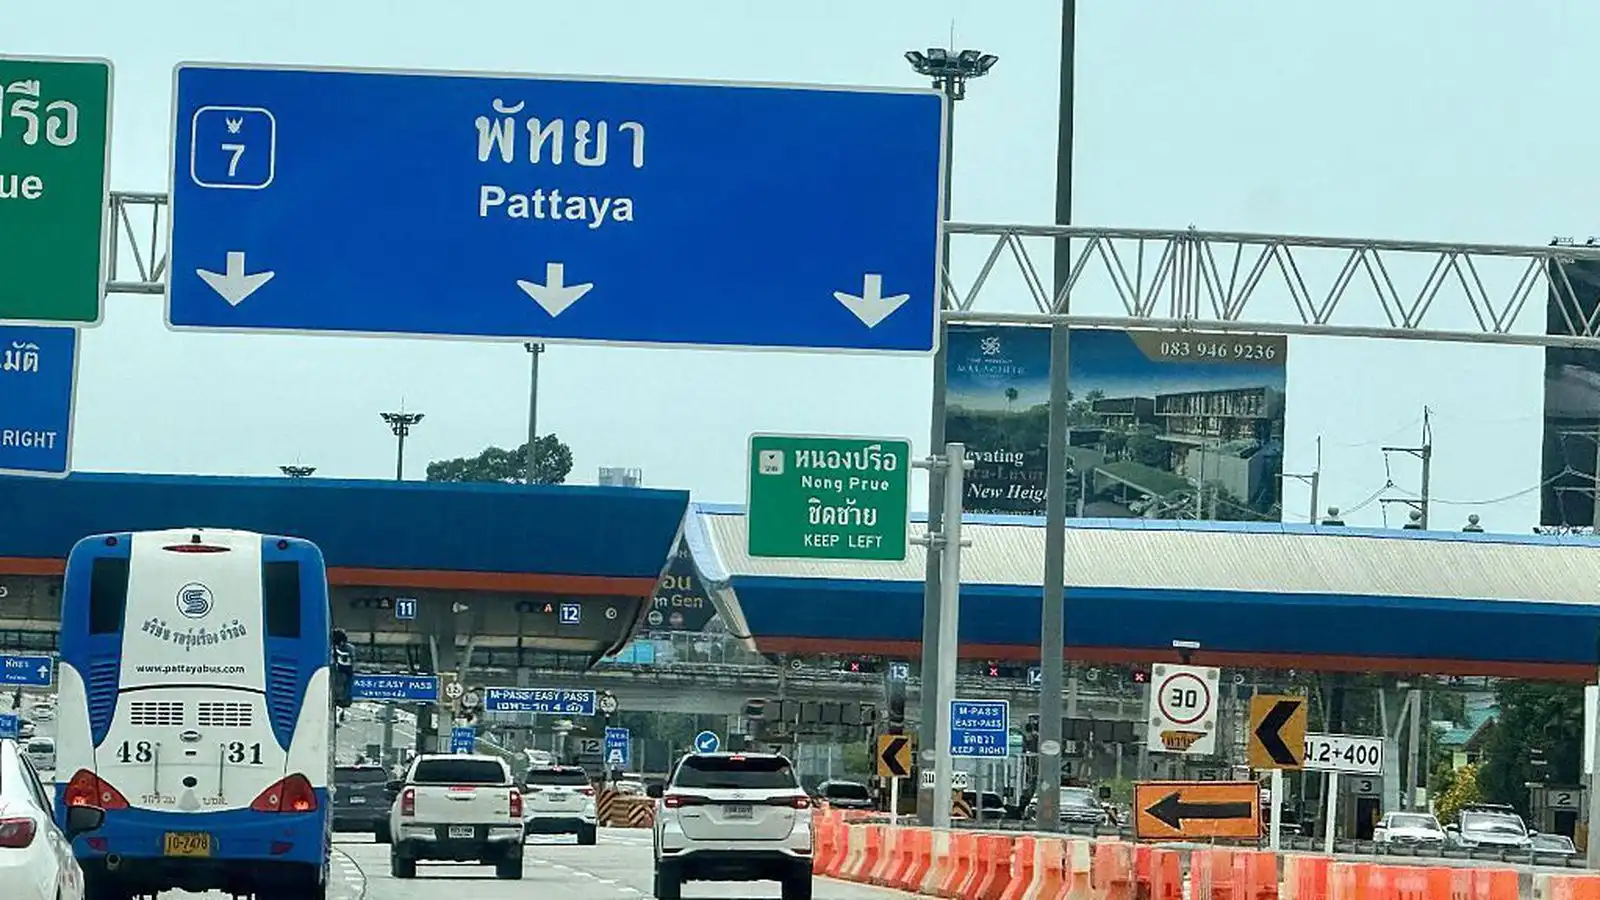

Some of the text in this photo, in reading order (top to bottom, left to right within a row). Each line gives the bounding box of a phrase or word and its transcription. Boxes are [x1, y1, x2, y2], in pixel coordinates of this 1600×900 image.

[0, 80, 78, 146] รือ
[475, 98, 645, 168] พัทยา
[221, 143, 245, 177] 7
[480, 185, 633, 229] Pattaya
[0, 341, 40, 372] มัติ
[1161, 342, 1275, 359] 083 946 9236
[2, 429, 57, 449] RIGHT
[795, 444, 897, 472] หนองปรือ
[802, 475, 889, 492] Nong Prue
[967, 483, 1003, 498] New
[808, 497, 877, 526] ชิดซ้าย
[804, 534, 883, 548] KEEP LEFT
[399, 602, 413, 615] 11
[671, 594, 703, 608] Gen
[562, 606, 579, 621] 12
[136, 664, 245, 675] www.pattayabus.com
[893, 665, 907, 679] 13
[563, 691, 589, 702] PASS
[1171, 688, 1197, 708] 30
[959, 706, 1000, 716] M-PASS
[117, 741, 263, 764] 48 31
[581, 740, 599, 753] 12
[1360, 780, 1372, 793] 3
[1557, 793, 1571, 805] 2
